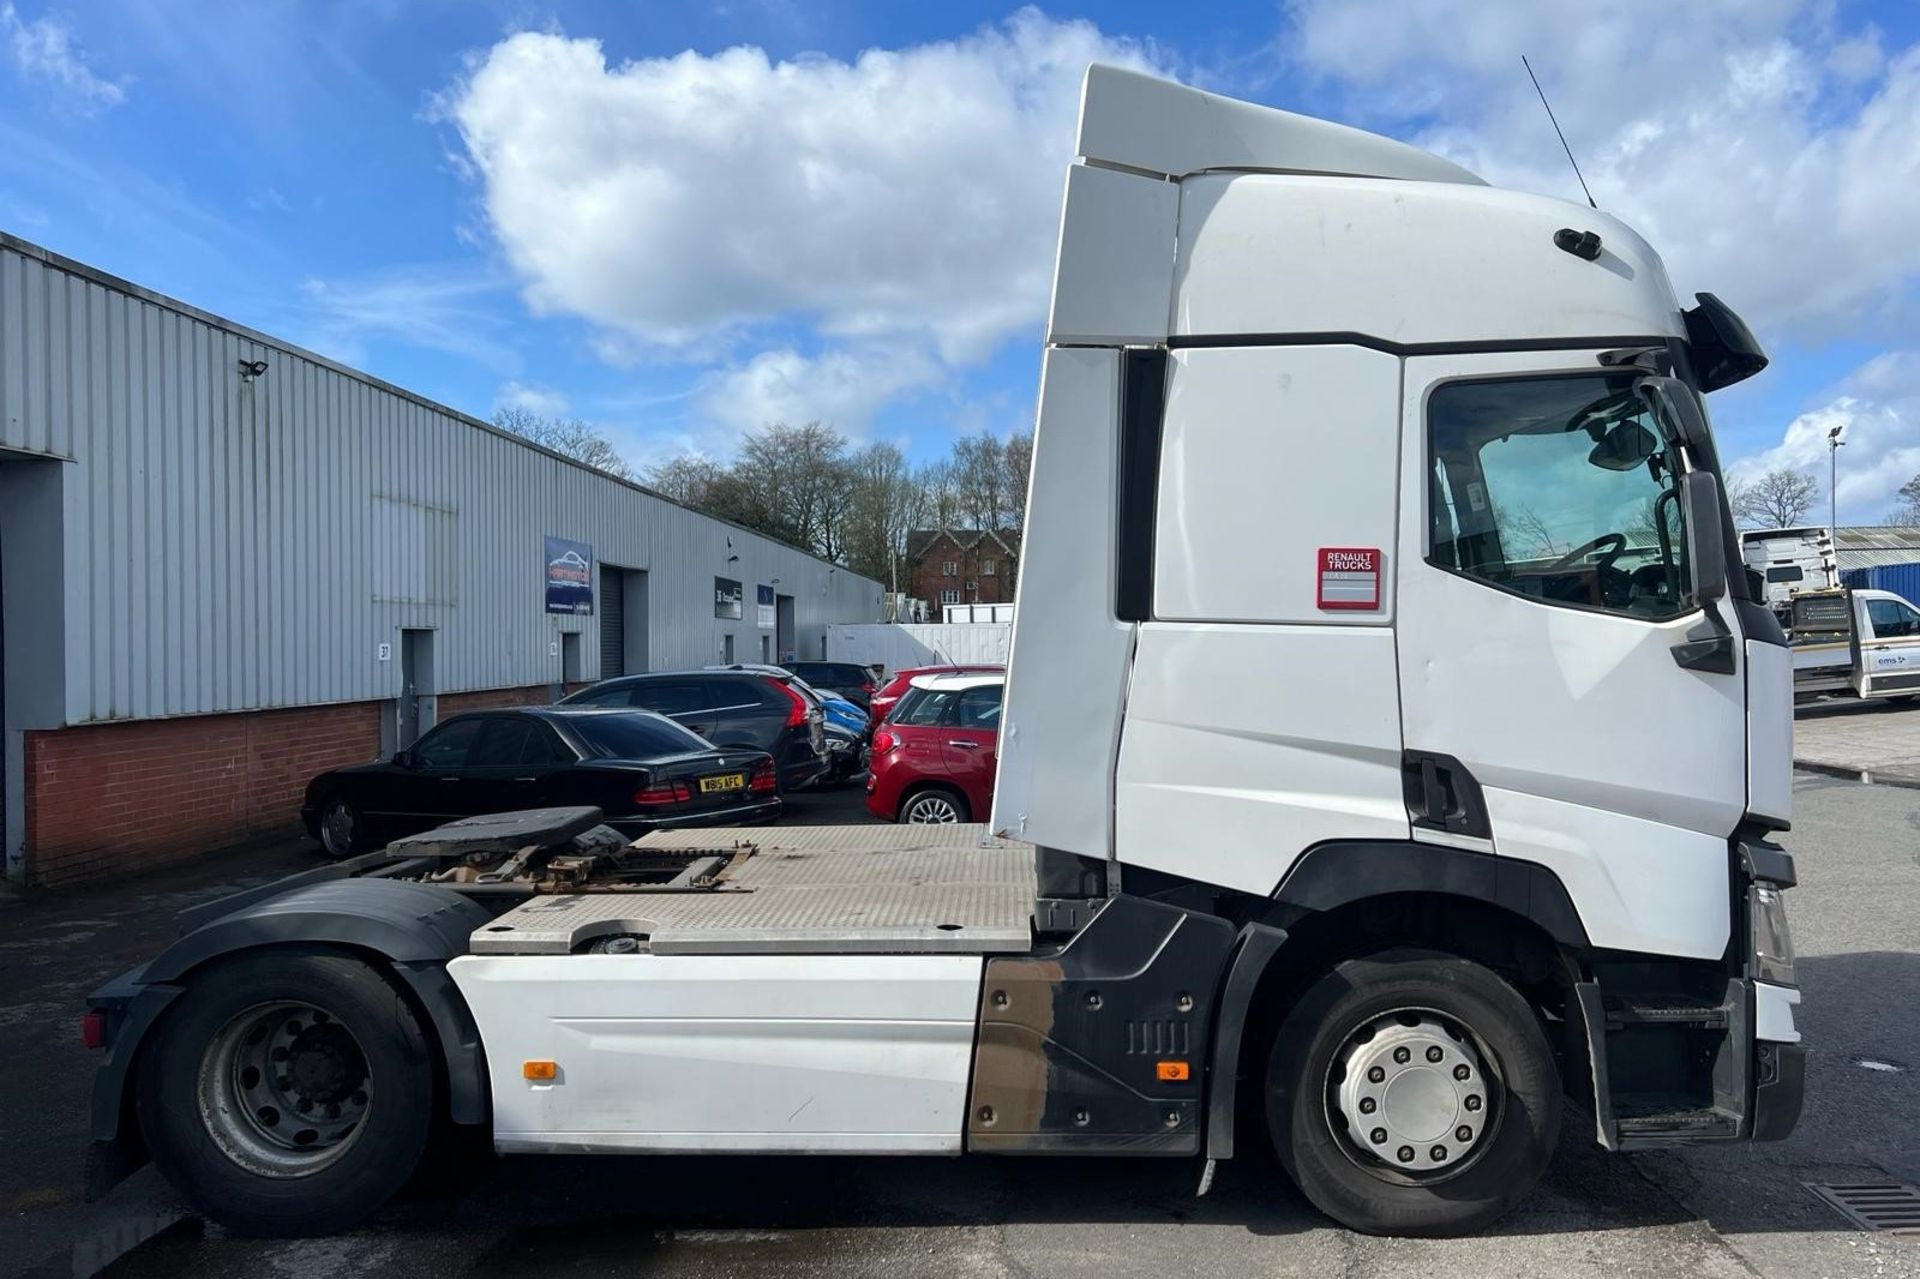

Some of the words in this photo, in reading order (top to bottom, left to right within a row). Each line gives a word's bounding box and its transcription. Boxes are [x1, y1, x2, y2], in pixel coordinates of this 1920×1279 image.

[1327, 552, 1372, 561] RENAULT
[1327, 561, 1372, 570] TRUCKS
[724, 776, 740, 787] AFC
